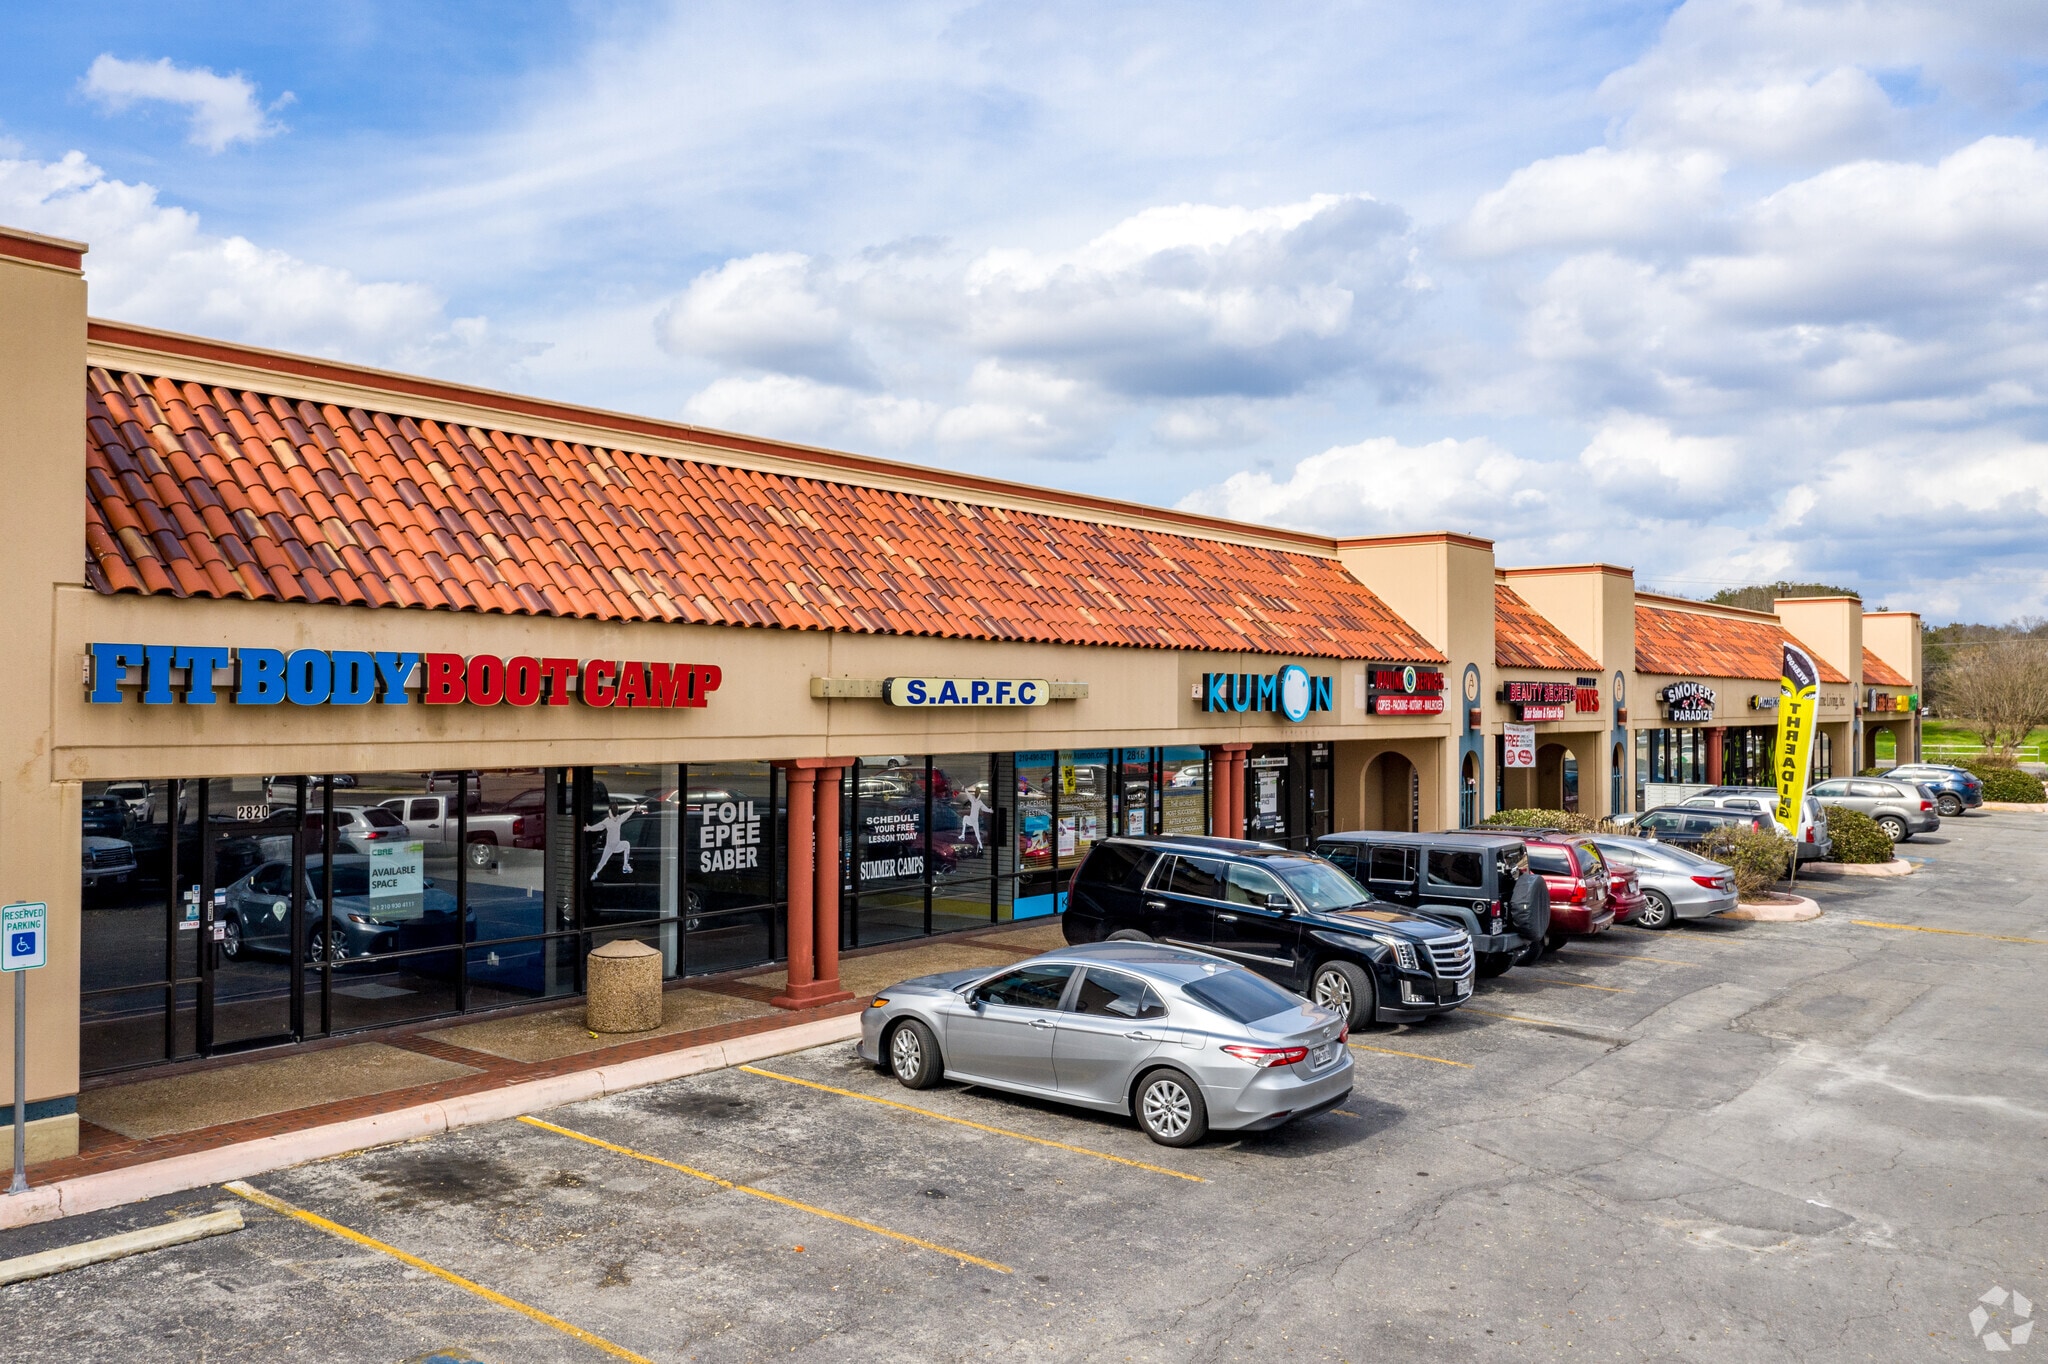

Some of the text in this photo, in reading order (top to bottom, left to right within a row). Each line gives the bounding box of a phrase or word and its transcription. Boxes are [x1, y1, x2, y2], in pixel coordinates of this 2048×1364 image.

[89, 642, 723, 709] FIT BODY BOOT CAMP
[906, 679, 1037, 705] S.A.P.F.C
[1207, 664, 1333, 723] KUMON
[1509, 682, 1577, 703] BEAUTY SECRETS
[1668, 683, 1717, 704] SMOKERZ
[1525, 706, 1533, 719] Hair
[1533, 706, 1543, 719] Salon
[1547, 706, 1557, 719] Facial
[1674, 710, 1713, 721] PARADIZE
[1505, 734, 1520, 748] FREE
[1126, 750, 1146, 761] 2816
[1018, 799, 1051, 808] PLACEMENT
[1127, 792, 1147, 803] KUMON
[238, 805, 269, 819] 2820
[702, 800, 761, 825] FOIL
[1025, 808, 1049, 817] TESTING
[866, 813, 920, 825] SCHEDULE
[874, 823, 915, 834] YOUR FREE
[700, 822, 761, 849] EPEE
[868, 832, 918, 844] LESSON TODAY
[372, 848, 393, 856] CBRE
[700, 846, 758, 873] SABER
[372, 865, 416, 877] AVAILABLE
[860, 856, 924, 880] SUMMER CAMPS
[371, 879, 398, 890] SPACE
[4, 908, 44, 920] RESERVED
[7, 919, 42, 931] PARKING
